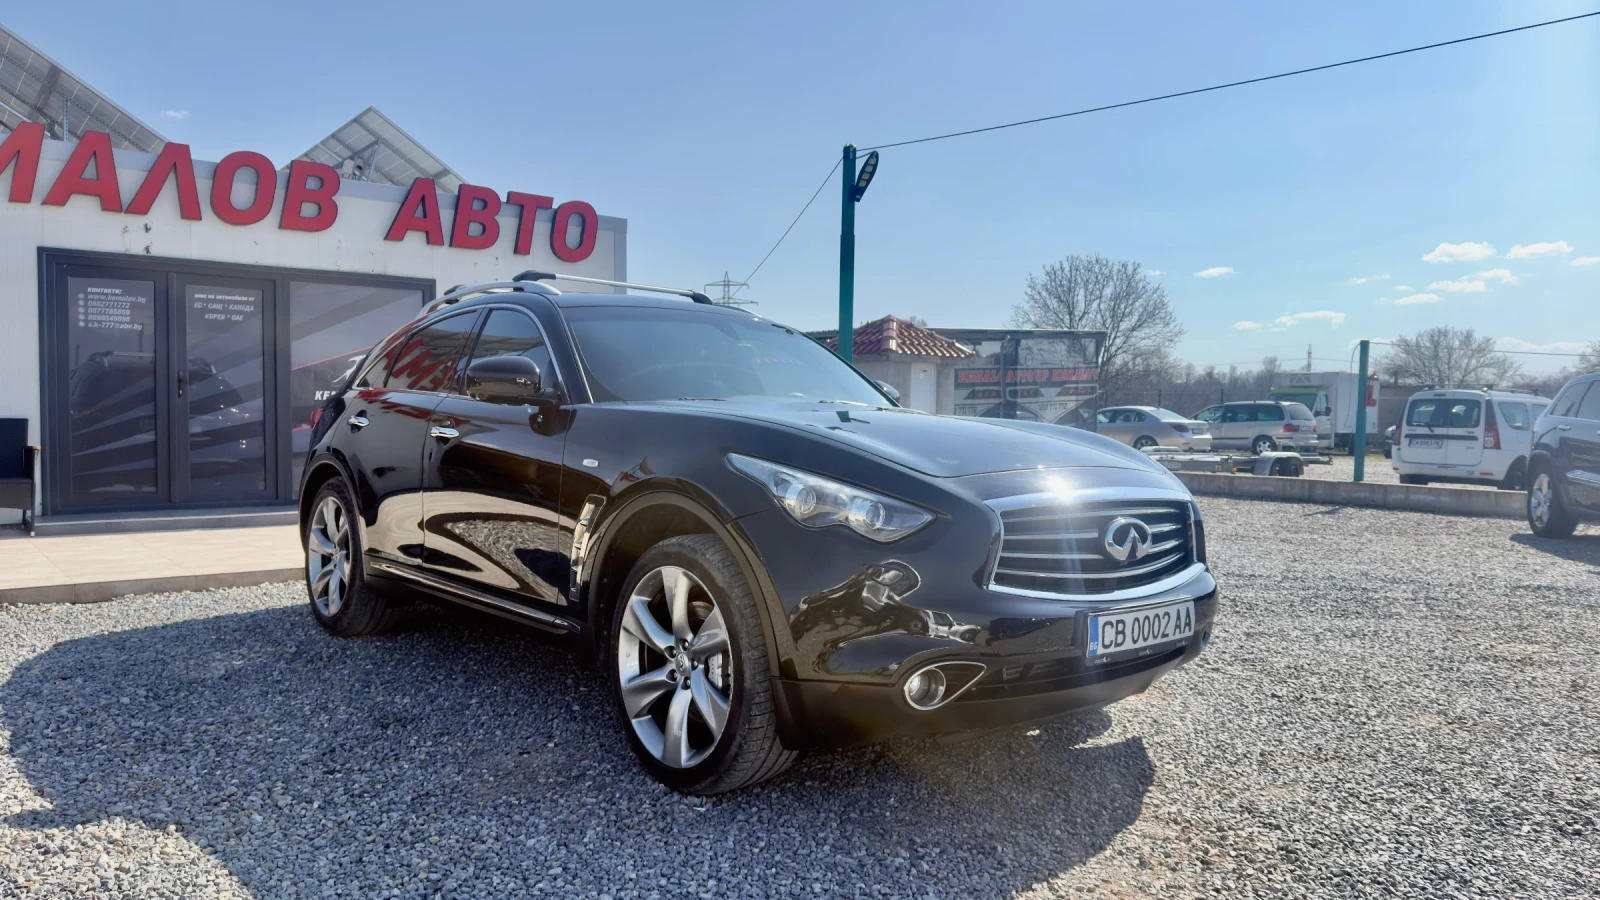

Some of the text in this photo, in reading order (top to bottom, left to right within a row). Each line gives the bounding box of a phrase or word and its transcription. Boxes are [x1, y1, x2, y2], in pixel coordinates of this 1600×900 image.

[384, 177, 598, 263] АВТО
[87, 294, 147, 303] www.kemalov.bg
[87, 300, 131, 308] 0882771772
[207, 302, 223, 310] САЩ
[228, 303, 255, 312] КАНАДА
[958, 369, 1001, 383] KEMAL
[1052, 368, 1099, 382] KEMALOV
[314, 390, 337, 401] KE
[1101, 606, 1192, 650] CB 0002 AA
[1089, 641, 1098, 651] BG
